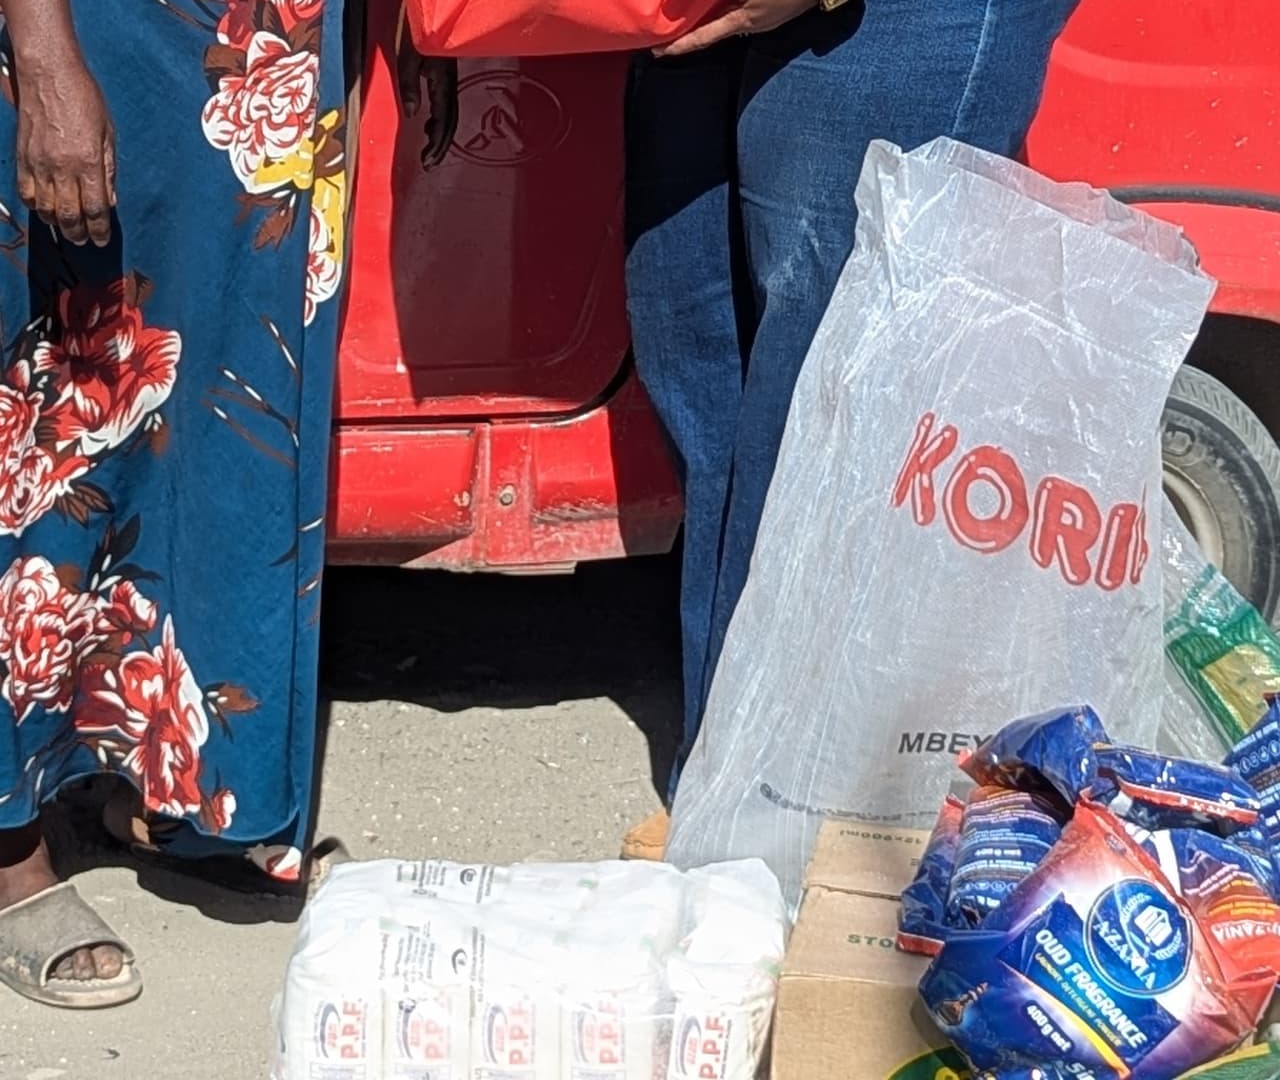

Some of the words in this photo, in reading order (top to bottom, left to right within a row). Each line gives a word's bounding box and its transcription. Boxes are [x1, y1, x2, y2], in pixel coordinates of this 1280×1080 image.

[898, 732, 998, 754] MBEY
[848, 934, 894, 948] STO
[1035, 929, 1072, 965] OUD
[1064, 962, 1148, 1048] FRAGRANCE
